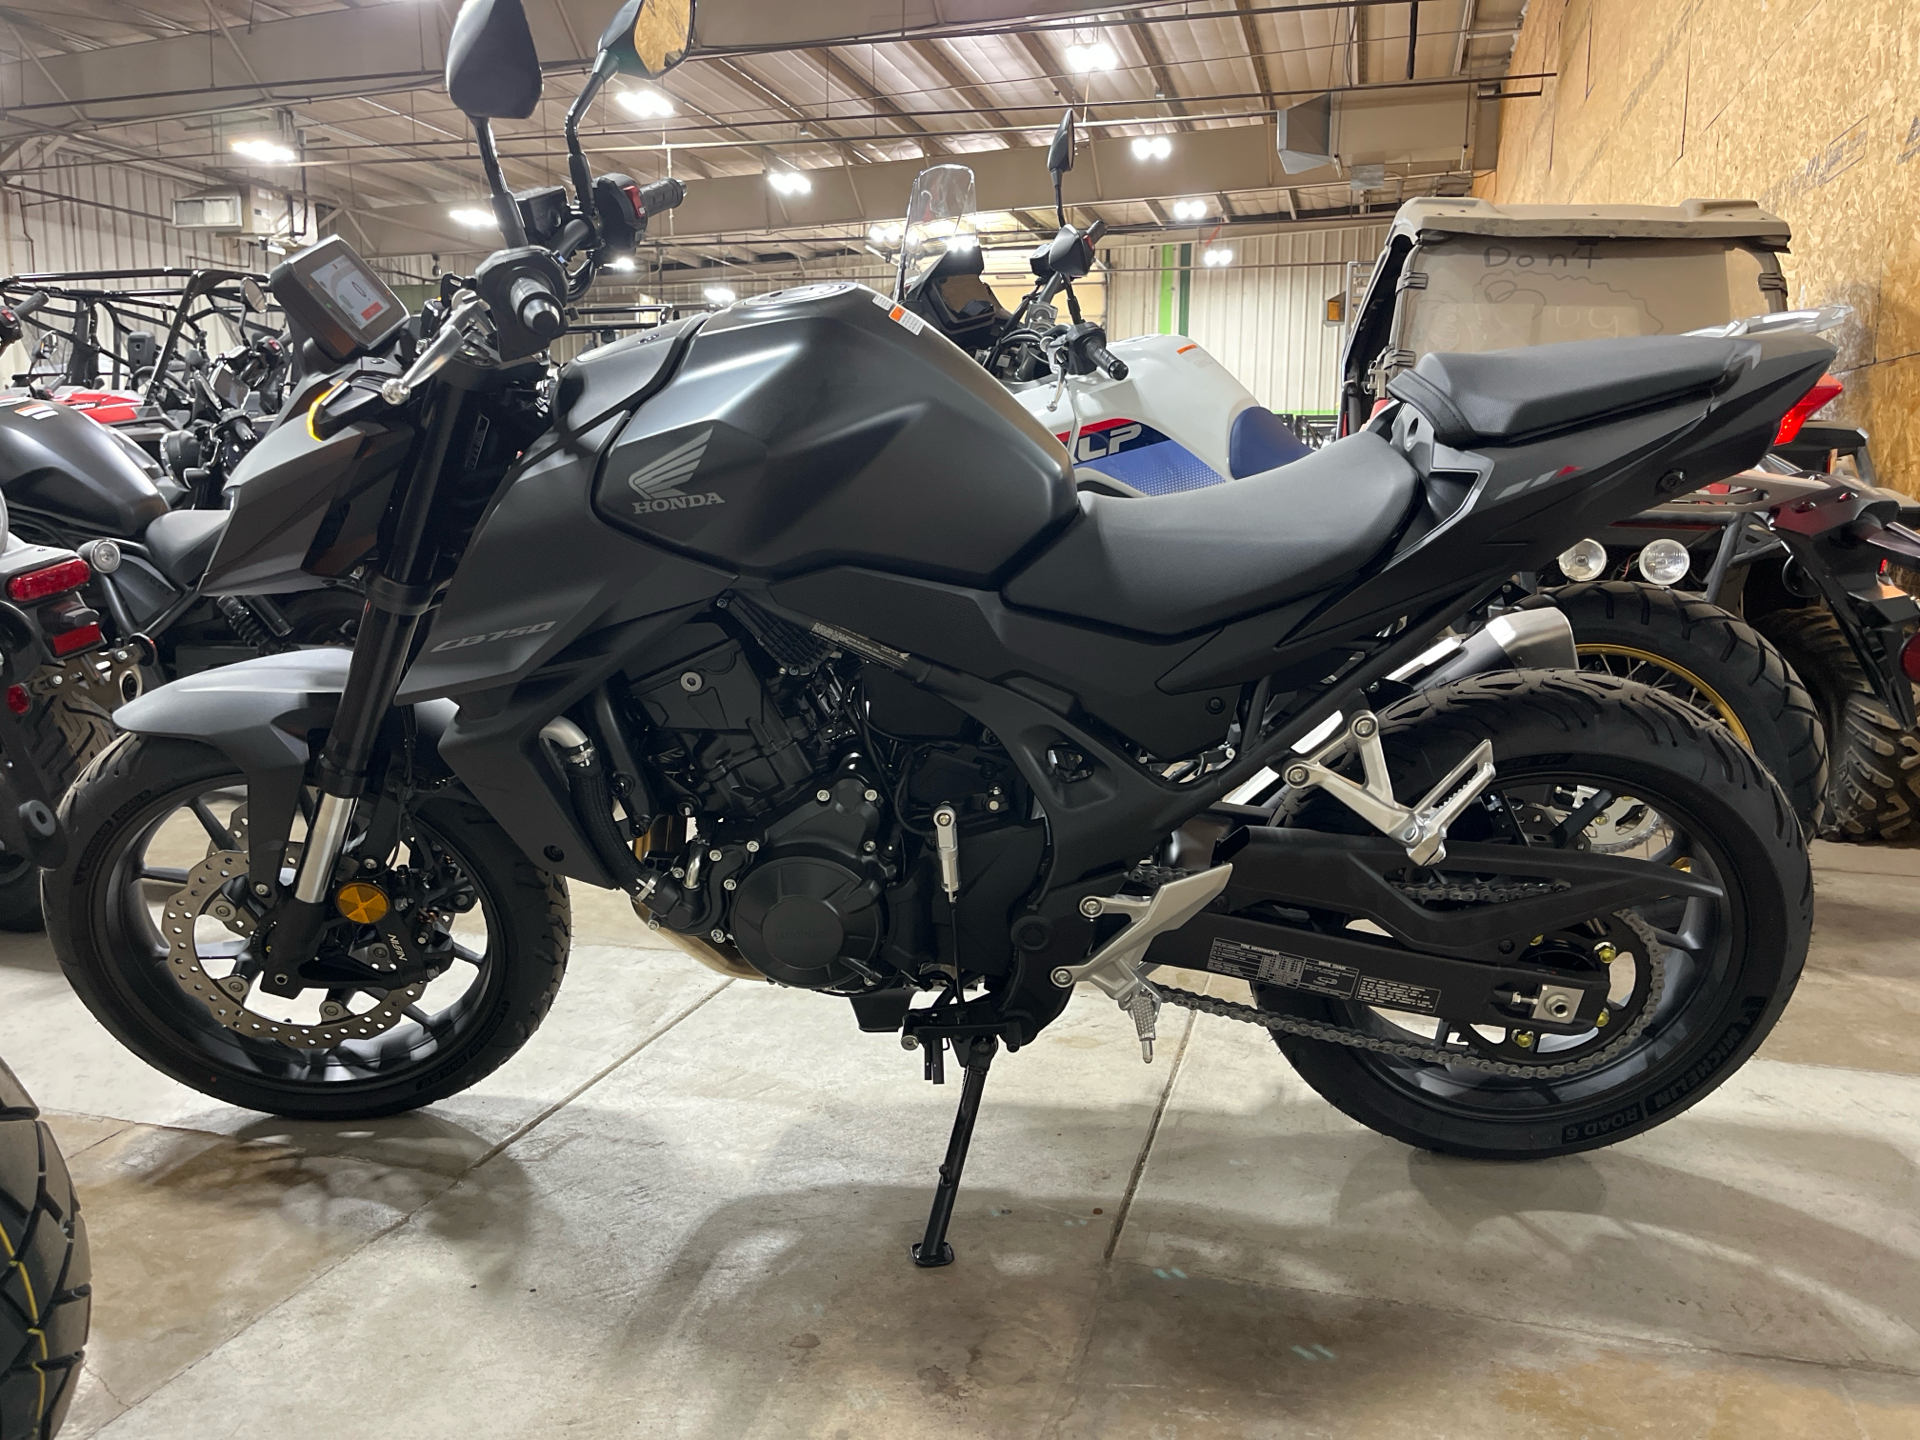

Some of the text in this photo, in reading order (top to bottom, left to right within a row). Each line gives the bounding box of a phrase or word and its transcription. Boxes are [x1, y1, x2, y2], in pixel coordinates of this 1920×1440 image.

[1484, 245, 1603, 270] Don't
[631, 492, 726, 515] HONDA
[430, 620, 557, 653] CB750
[1565, 1026, 1743, 1140] MICHELIN ROAD 6
